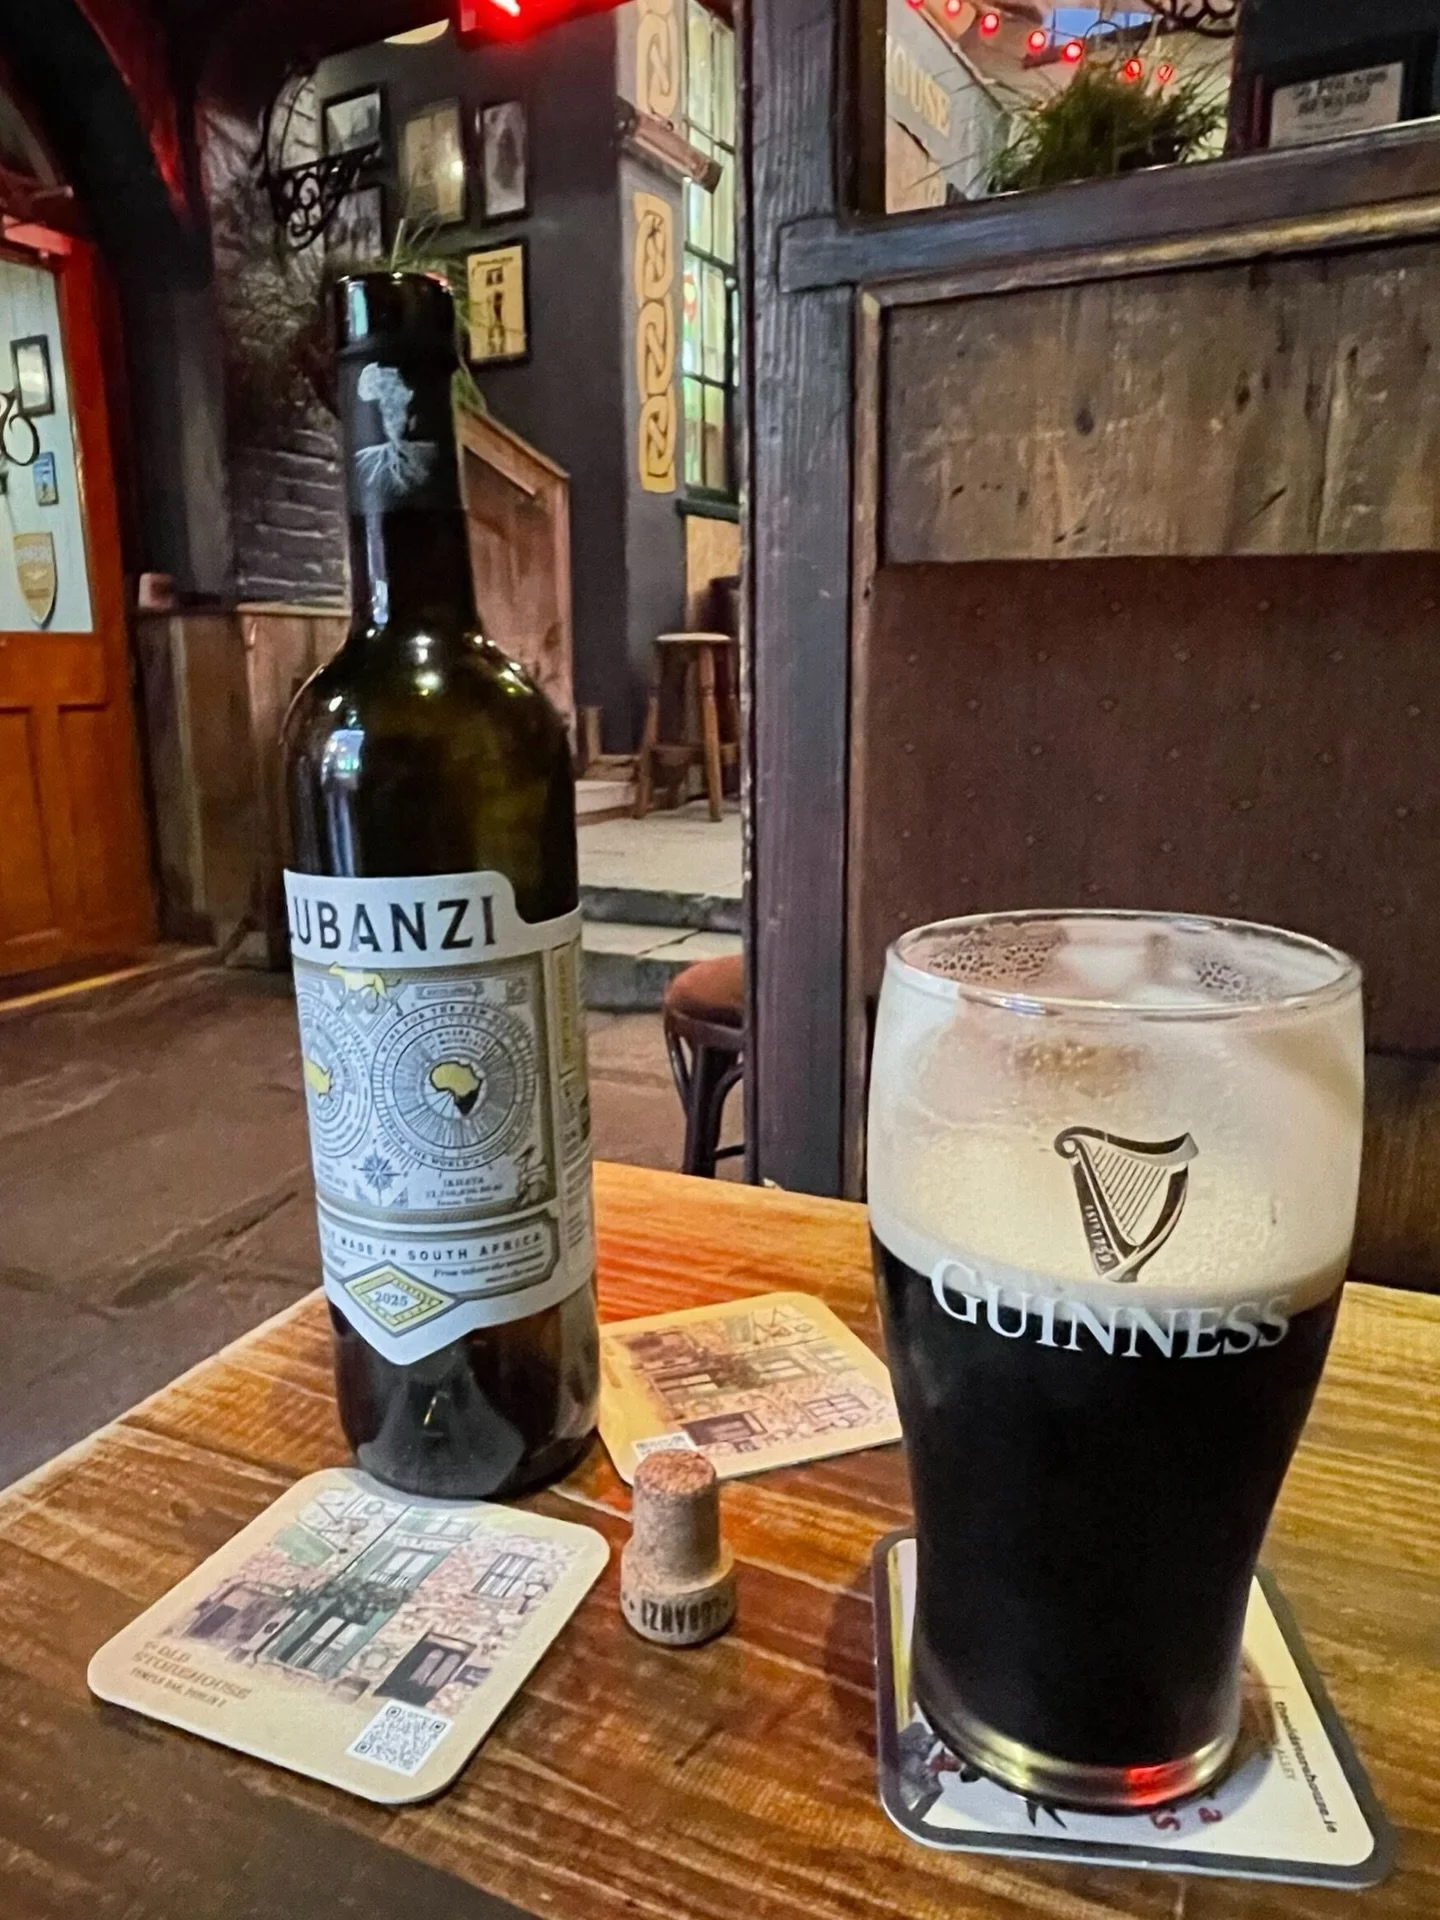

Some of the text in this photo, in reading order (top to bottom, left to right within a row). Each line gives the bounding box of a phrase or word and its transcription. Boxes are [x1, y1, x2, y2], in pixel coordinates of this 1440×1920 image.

[291, 895, 497, 952] UBANZI
[407, 1249, 468, 1261] SOUTH
[479, 1232, 541, 1257] AFRICA
[931, 1258, 1291, 1359] GUINNESS
